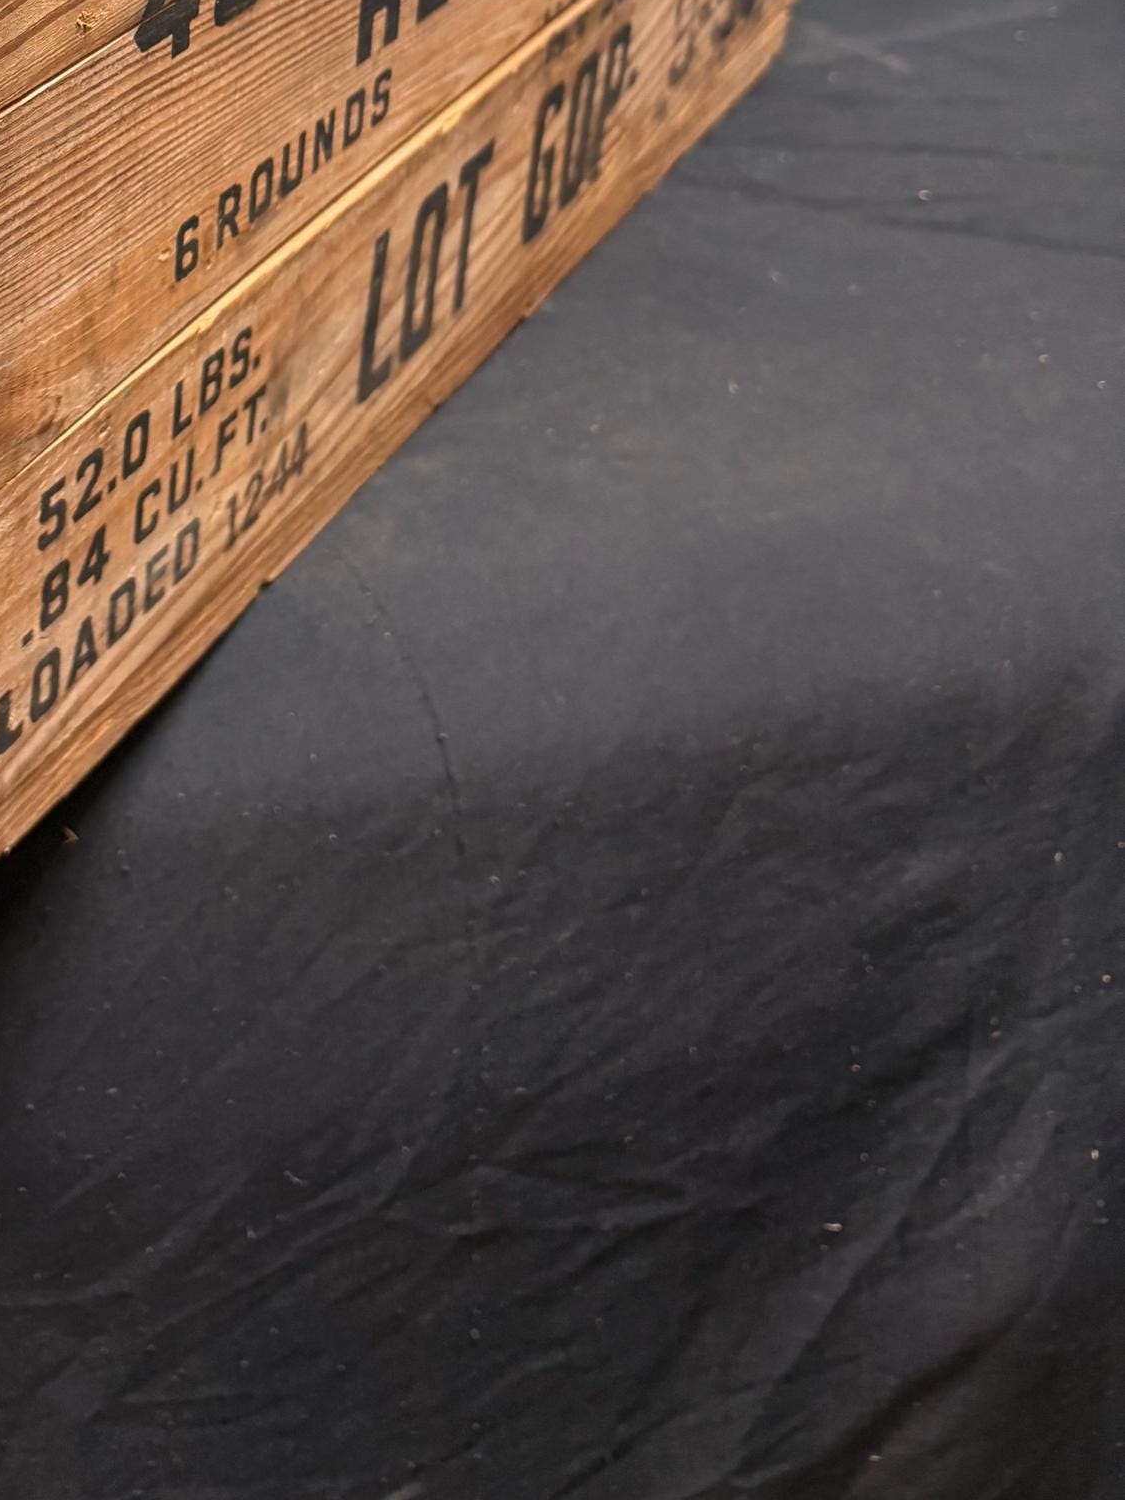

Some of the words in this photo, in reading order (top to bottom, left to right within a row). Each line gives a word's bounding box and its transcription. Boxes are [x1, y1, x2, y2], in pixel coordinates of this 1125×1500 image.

[174, 214, 200, 283] 6
[216, 69, 393, 252] ROUNDS
[355, 138, 496, 407] LOT
[36, 408, 150, 552] 52.0
[173, 325, 263, 440] LBS.
[22, 545, 111, 648] .84
